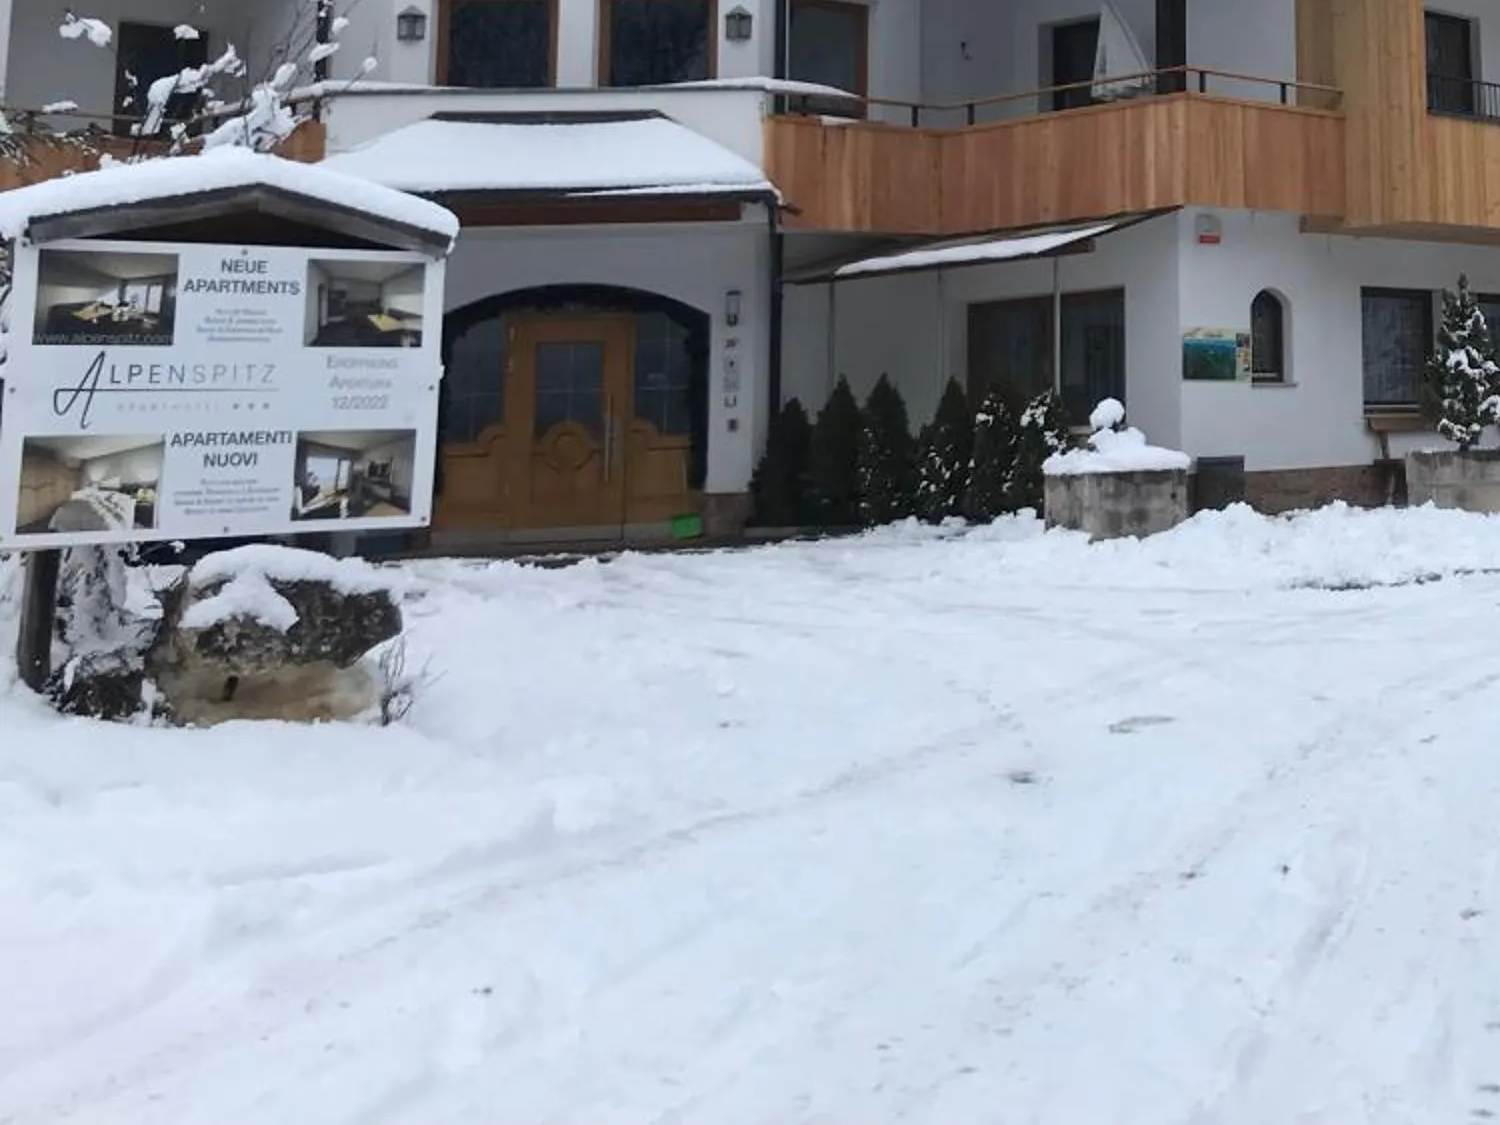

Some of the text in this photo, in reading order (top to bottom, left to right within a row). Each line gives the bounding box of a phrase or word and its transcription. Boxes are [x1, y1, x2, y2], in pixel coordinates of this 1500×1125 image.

[221, 259, 268, 274] NEUE
[183, 279, 301, 296] APARTMENTS
[53, 350, 279, 429] ALPENSPITZ
[170, 430, 293, 447] APARTAMENTI
[203, 452, 258, 467] NUOVI
